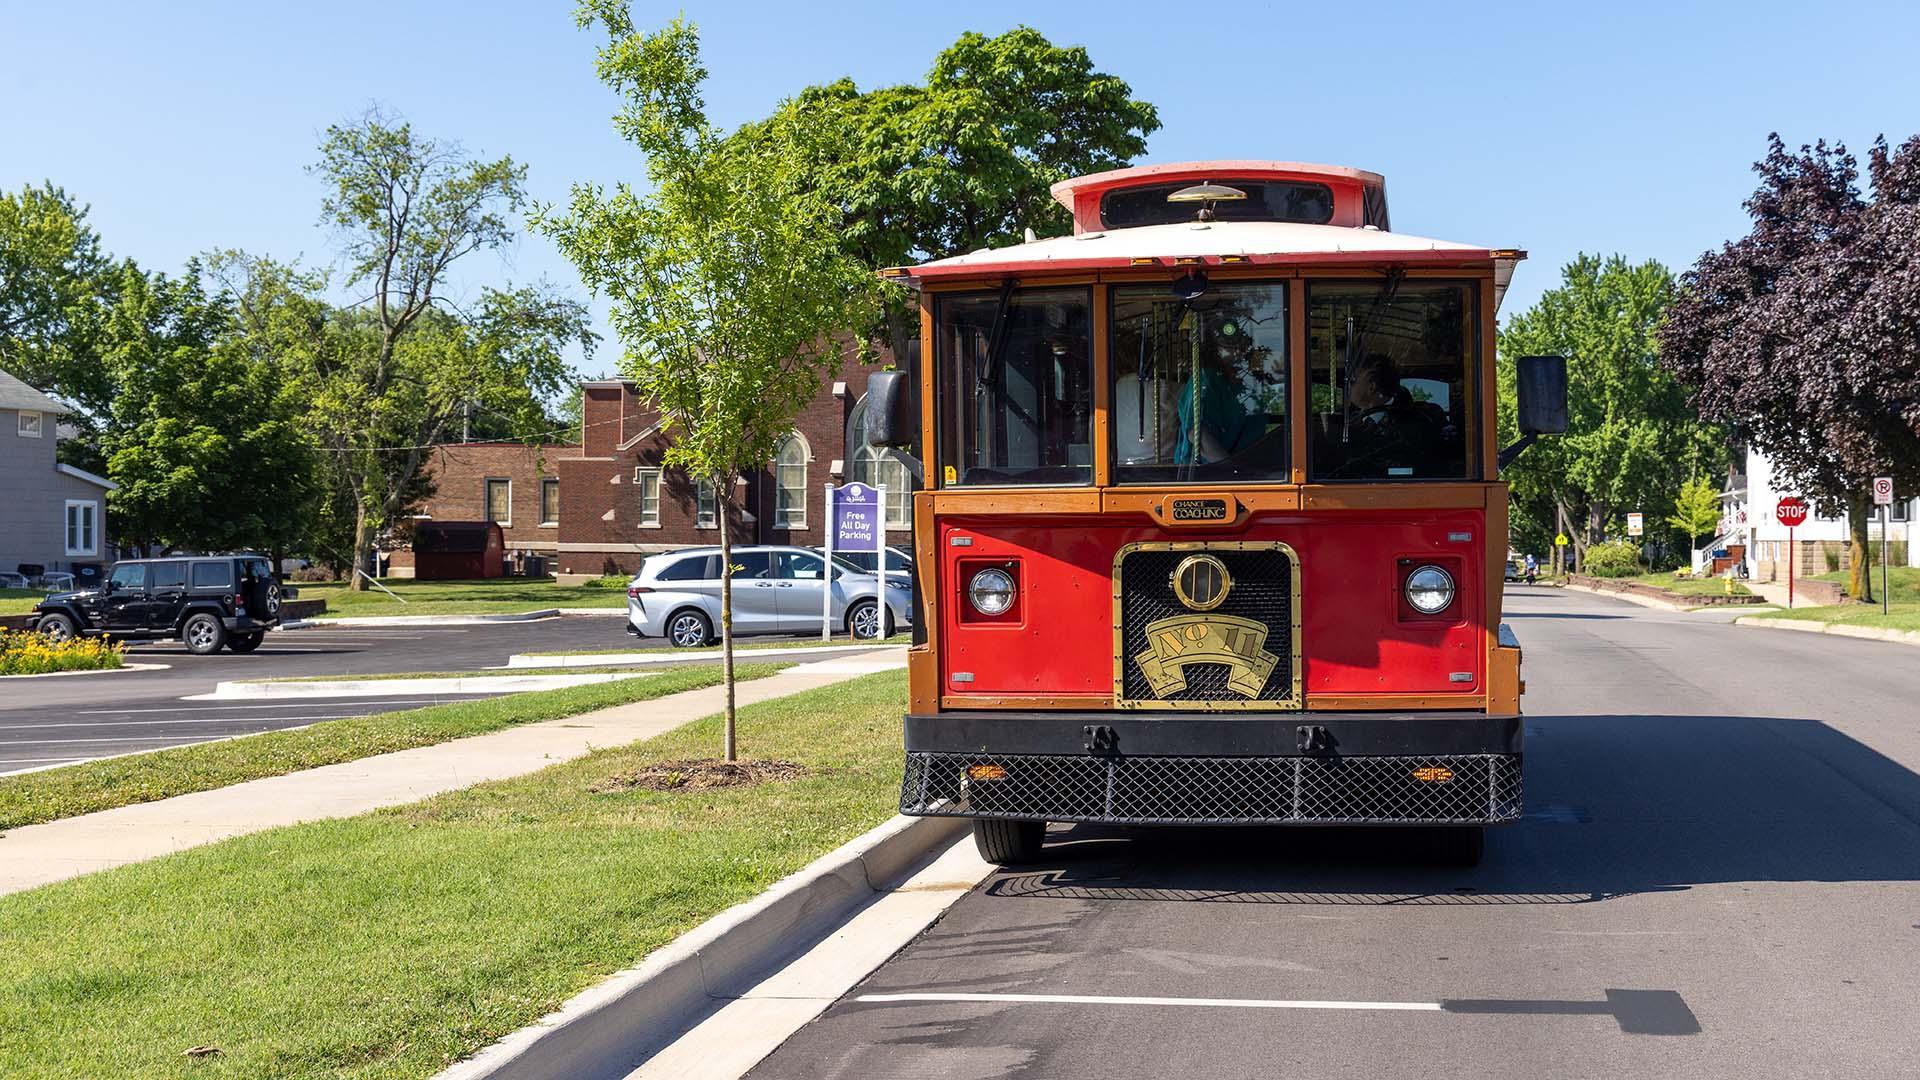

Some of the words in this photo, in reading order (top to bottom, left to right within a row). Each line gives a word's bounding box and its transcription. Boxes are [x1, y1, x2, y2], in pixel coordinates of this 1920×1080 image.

[846, 511, 865, 520] Free
[1777, 505, 1806, 518] STOP
[841, 521, 853, 530] All
[854, 521, 871, 531] Day
[840, 530, 872, 541] Parking
[1222, 627, 1258, 660] 11
